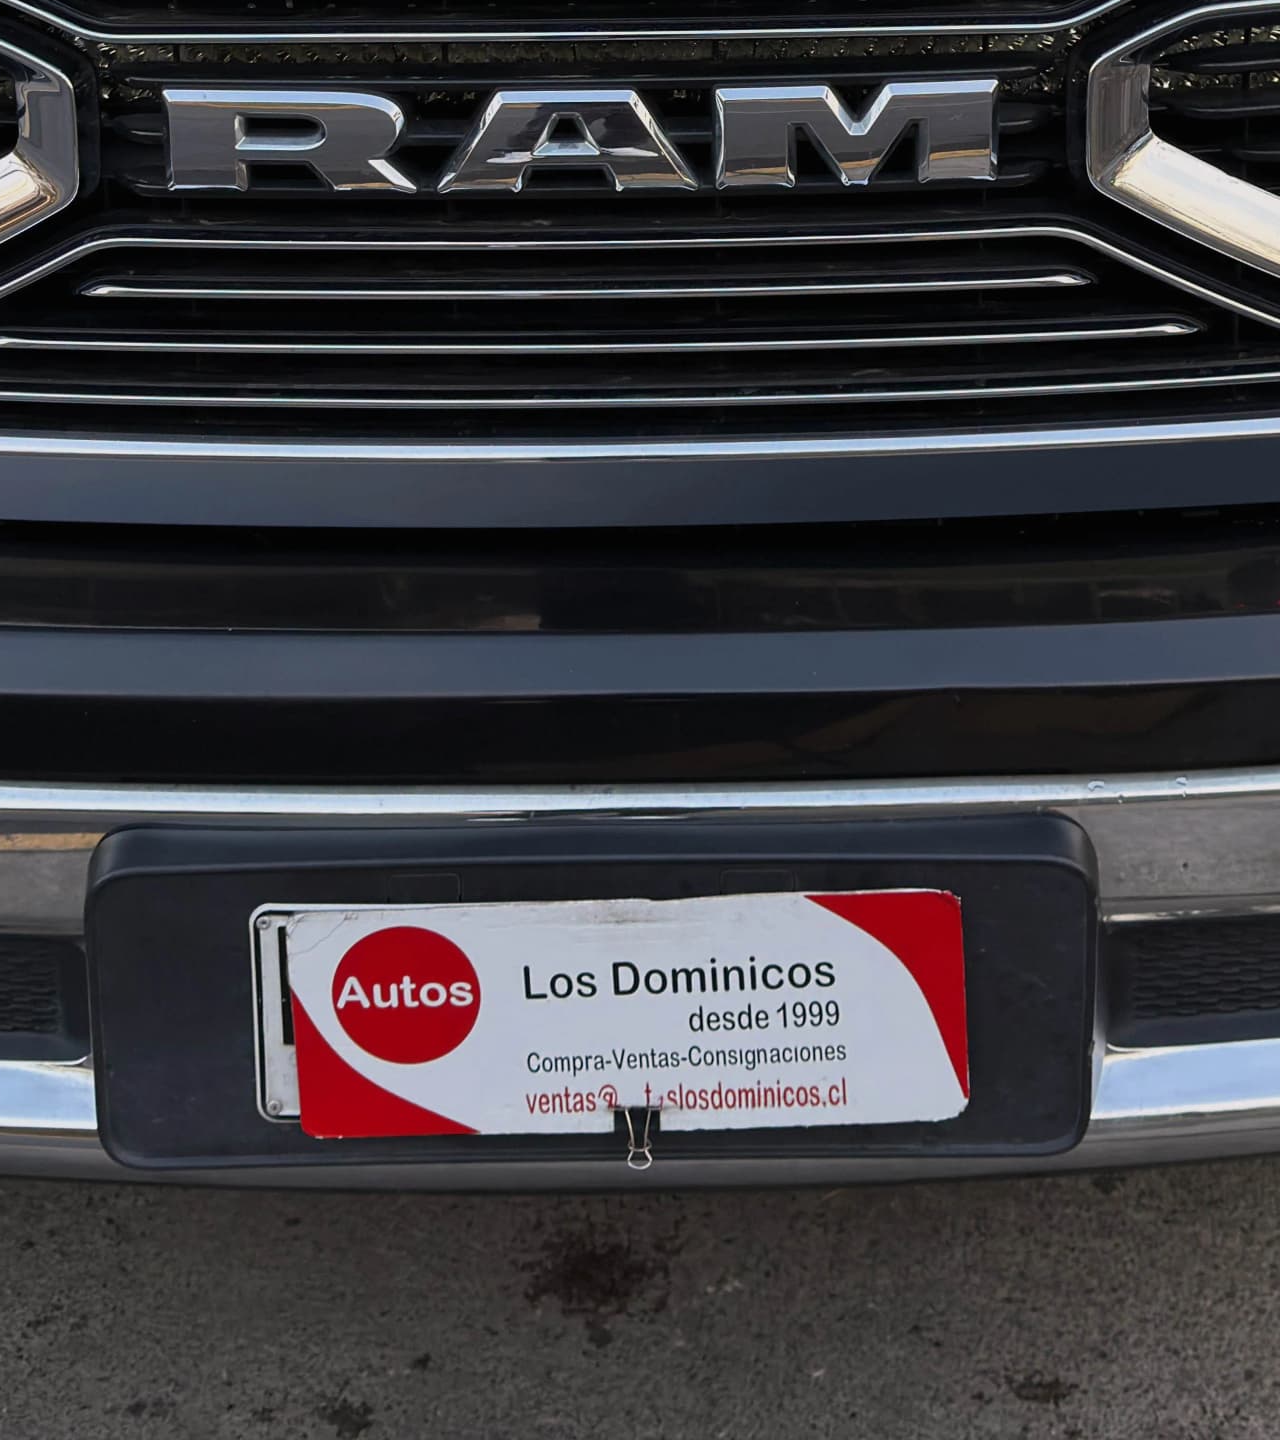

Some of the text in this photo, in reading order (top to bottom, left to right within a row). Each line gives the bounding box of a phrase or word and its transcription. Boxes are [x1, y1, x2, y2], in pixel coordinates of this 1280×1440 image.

[161, 79, 1000, 193] RAM
[336, 975, 474, 1010] Autos
[523, 956, 836, 1000] Los Dominicos
[688, 1000, 840, 1032] desde 1999
[526, 1044, 847, 1077] Compra-Ventas-Consignaciones
